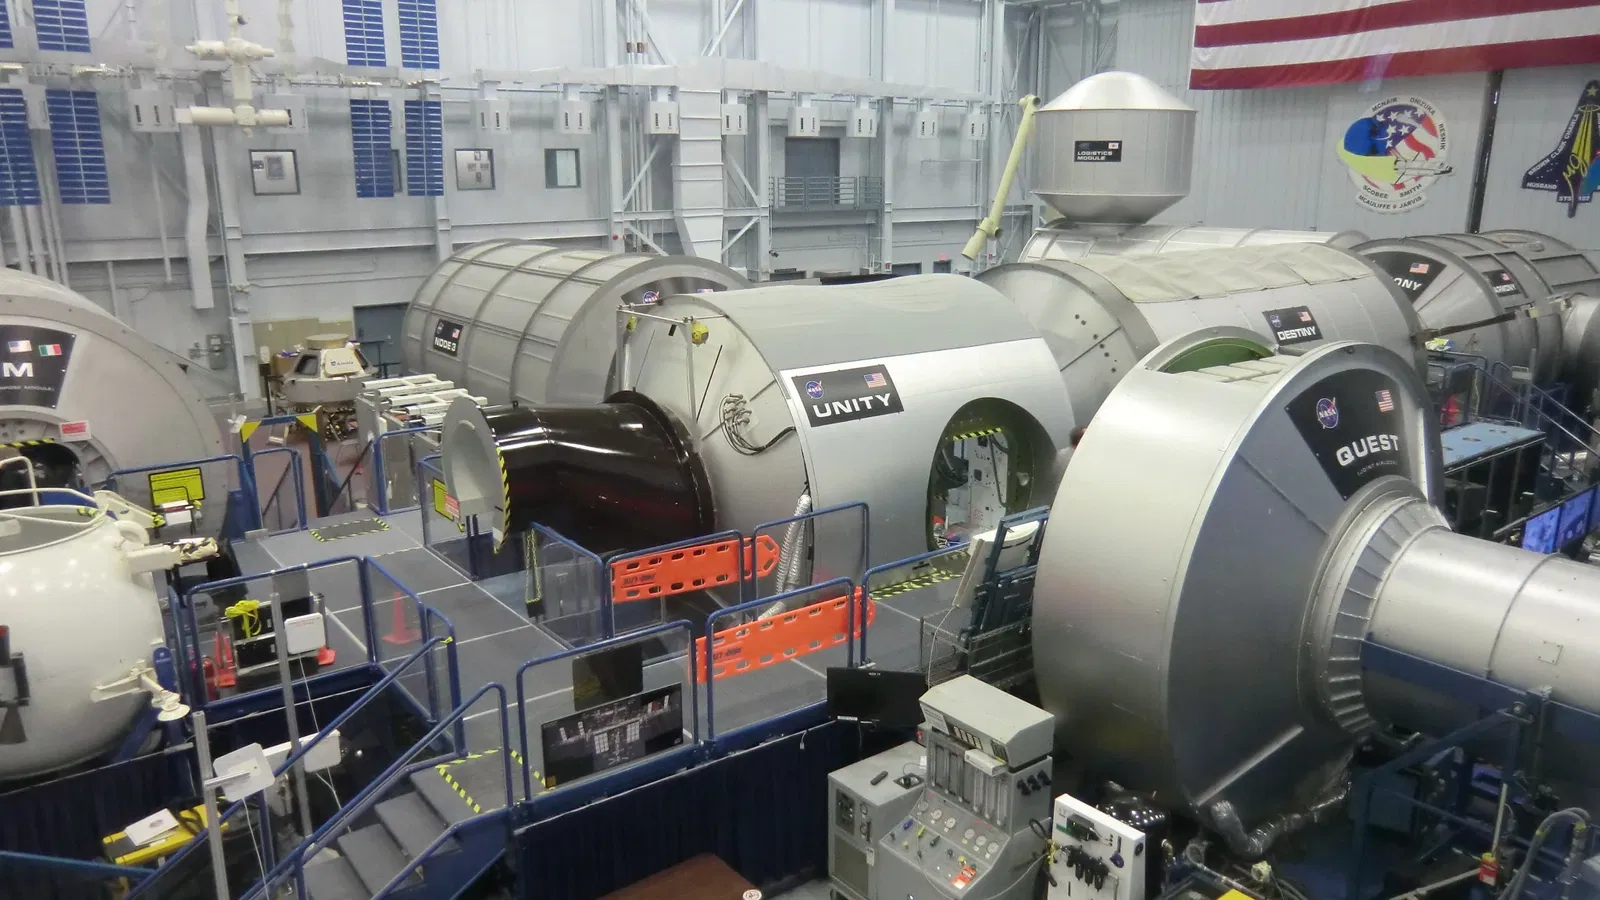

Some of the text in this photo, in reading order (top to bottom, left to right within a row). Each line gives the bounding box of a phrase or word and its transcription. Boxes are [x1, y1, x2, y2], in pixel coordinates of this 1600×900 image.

[1371, 97, 1398, 112] MCNAIR
[1409, 97, 1436, 116] ONIZUKA
[1438, 123, 1446, 150] RESNIK
[1528, 158, 1550, 176] BROWN
[1550, 140, 1567, 159] CLARK
[1362, 183, 1423, 199] SCOBEE SMITH
[1526, 182, 1557, 190] HUSBAND
[1358, 194, 1423, 210] MCAULIFFE JARVIS
[1277, 326, 1317, 341] DESTINY
[434, 337, 457, 352] NODE 3
[812, 392, 891, 418] UNITY
[1319, 408, 1337, 418] NASA
[1336, 434, 1399, 467] QUEST
